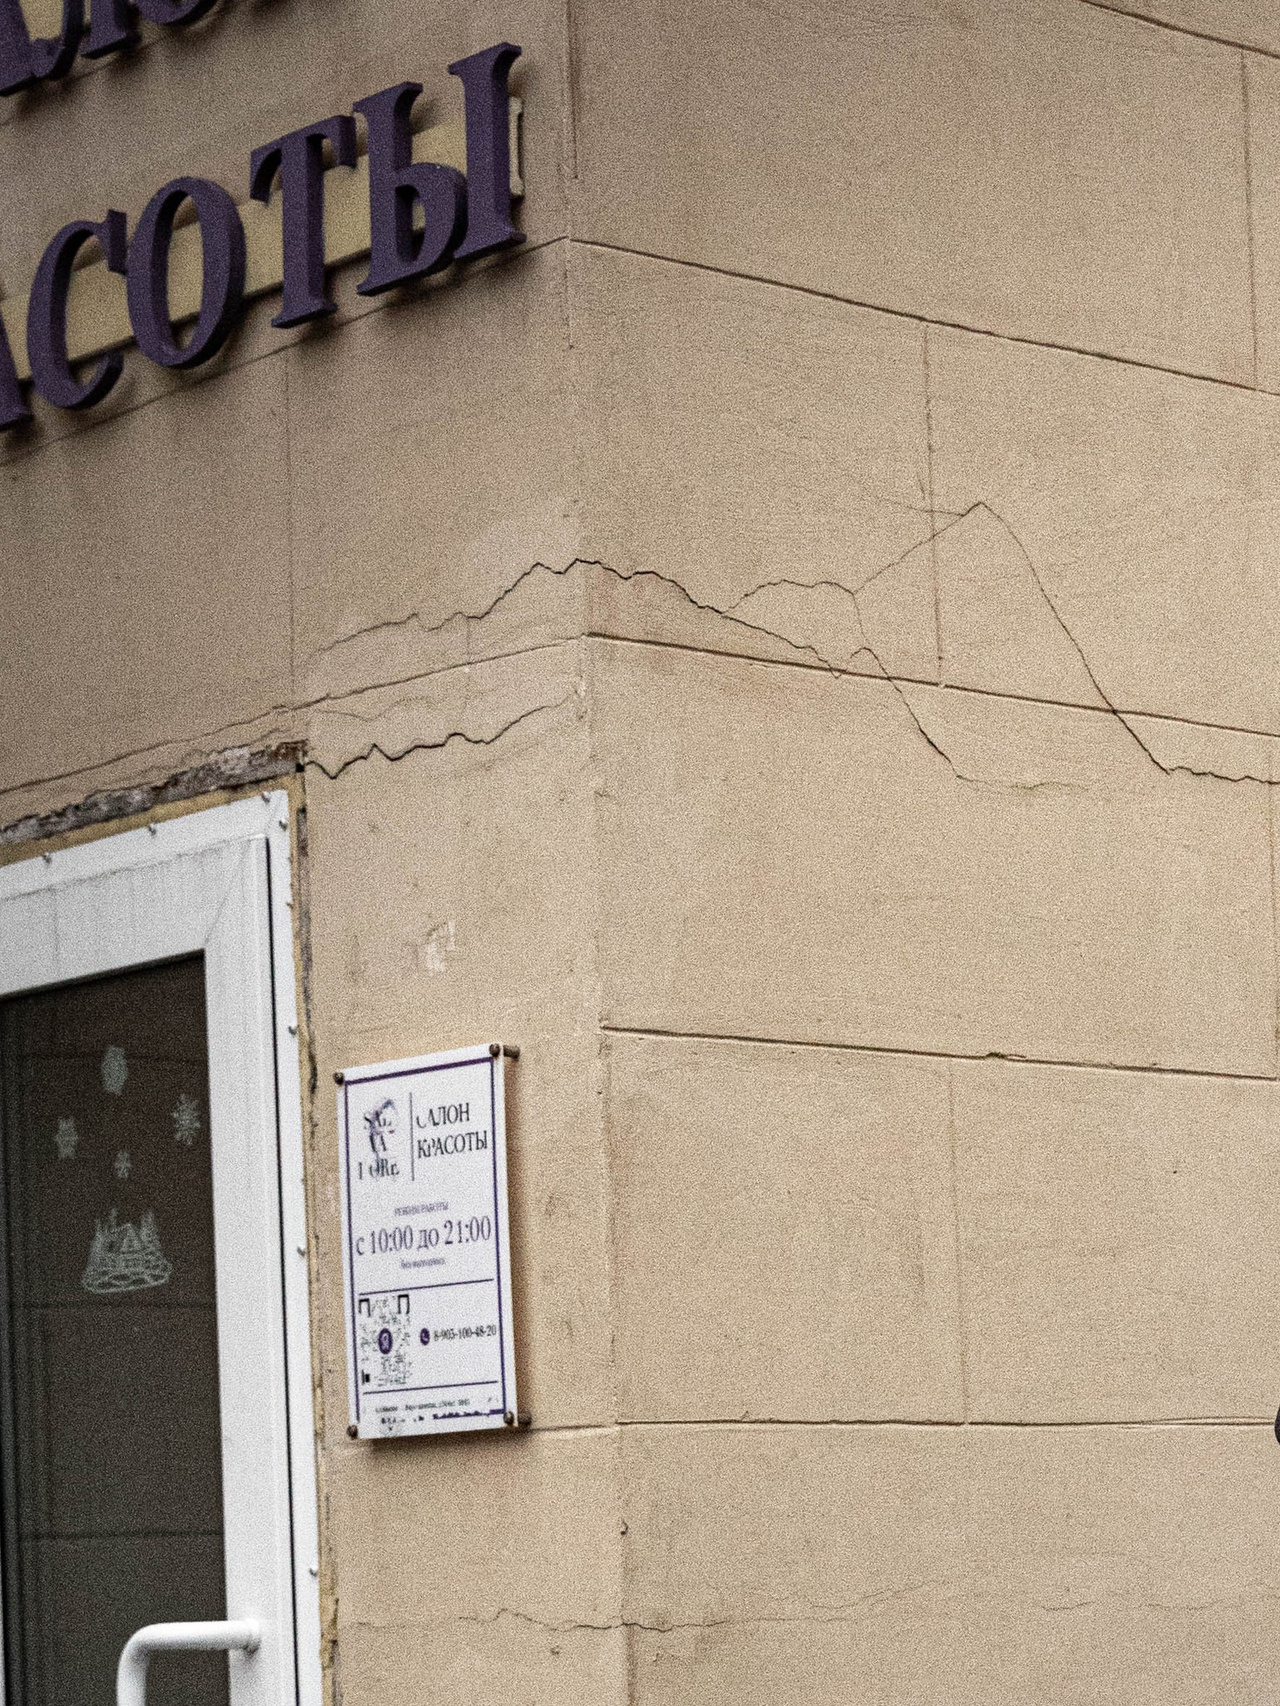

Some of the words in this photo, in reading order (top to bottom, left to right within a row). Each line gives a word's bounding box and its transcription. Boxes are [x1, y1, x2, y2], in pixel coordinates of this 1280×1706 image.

[0, 43, 526, 431] СОТЫ
[416, 1130, 488, 1159] КРАСОТЫ
[371, 1225, 414, 1254] 10:00
[417, 1228, 440, 1250] до
[443, 1215, 491, 1245] 21:00
